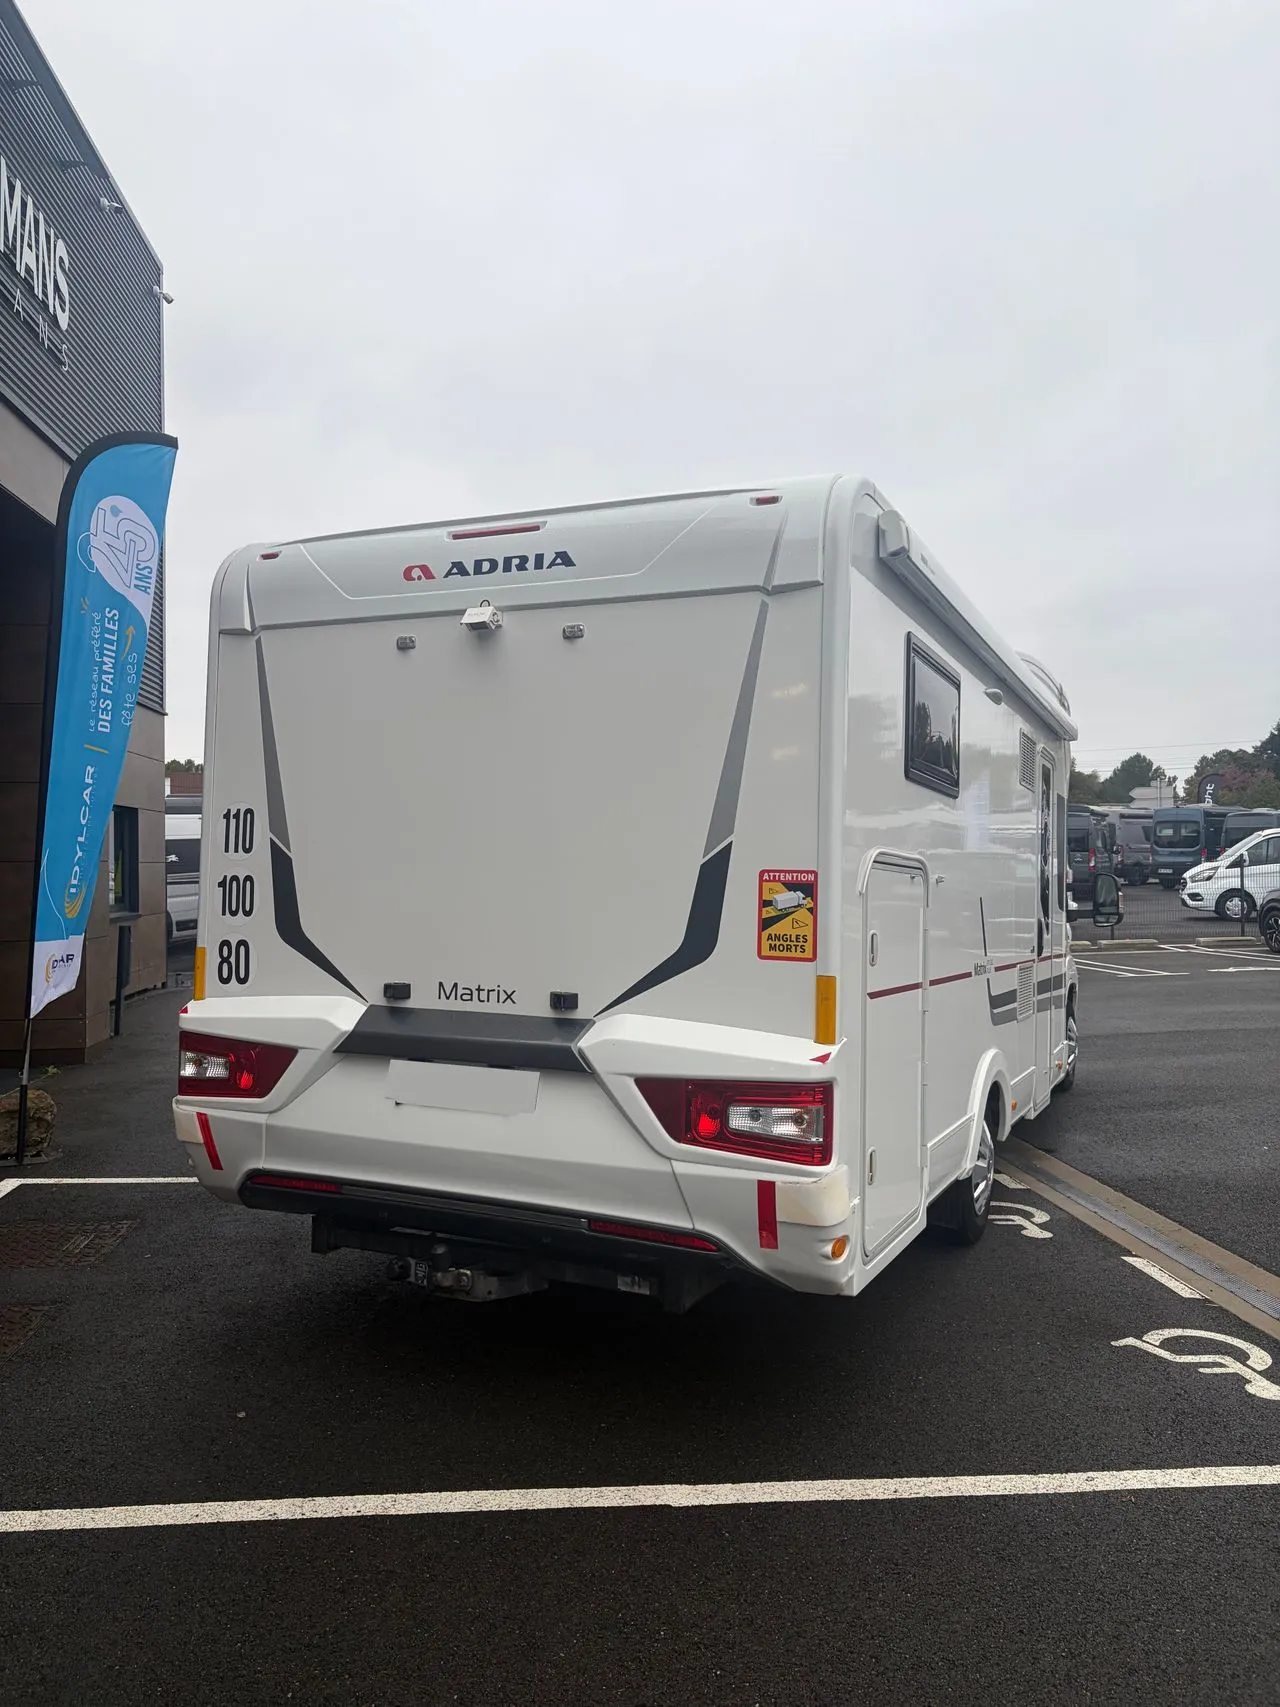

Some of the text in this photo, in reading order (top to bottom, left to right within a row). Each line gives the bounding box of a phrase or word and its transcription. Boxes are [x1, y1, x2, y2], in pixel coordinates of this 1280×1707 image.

[0, 155, 70, 331] MANS
[133, 562, 153, 596] ANS
[442, 550, 577, 579] ADRIA
[91, 611, 103, 662] préféré
[88, 666, 99, 712] réseau
[97, 607, 119, 733] DES FAMILLES
[126, 652, 138, 685] ses
[69, 764, 96, 893] IDYLCAR
[222, 807, 255, 854] 110
[217, 874, 255, 918] 100
[762, 872, 815, 881] ATTENTION
[766, 932, 808, 943] ANGLES
[768, 943, 806, 953] MORTS
[217, 939, 250, 985] 80
[437, 981, 517, 1005] Matrix
